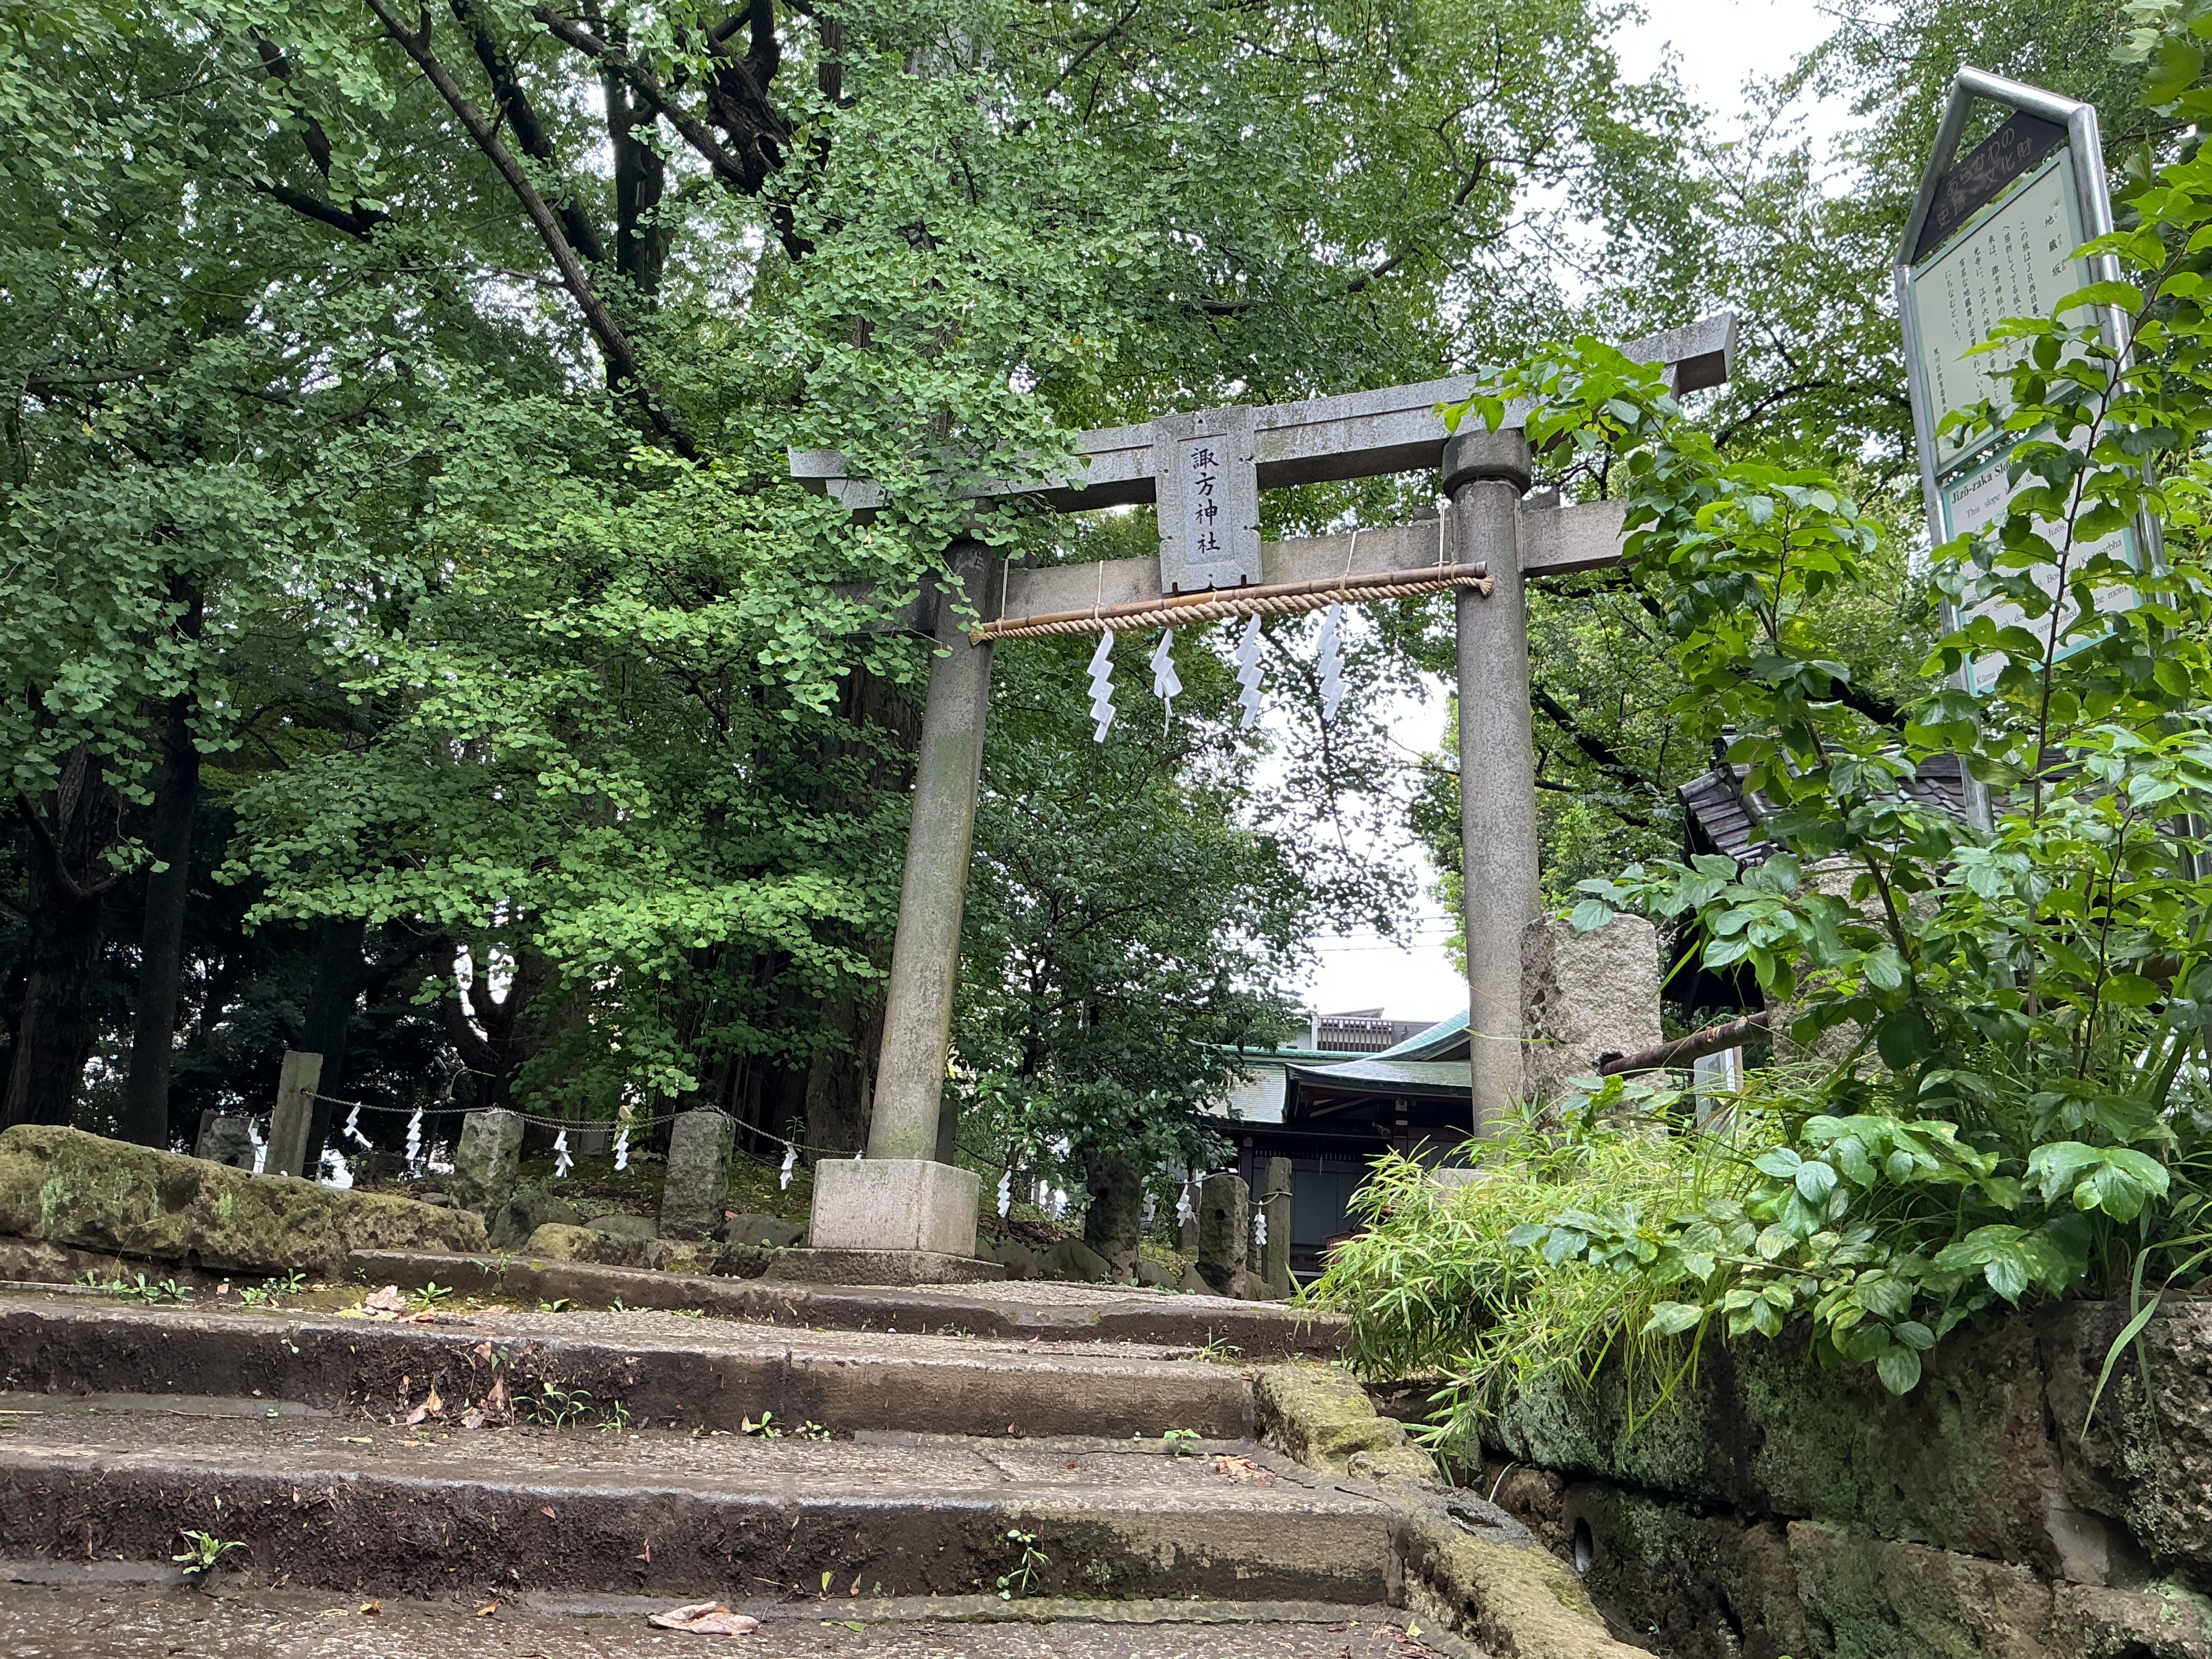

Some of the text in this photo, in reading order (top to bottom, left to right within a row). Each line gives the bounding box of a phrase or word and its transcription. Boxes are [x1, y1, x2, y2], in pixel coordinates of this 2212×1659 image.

[1946, 127, 2015, 197] あらかわの
[1190, 448, 1221, 554] 諏方神社
[1966, 505, 1980, 519] This
[1984, 494, 2001, 508] slope
